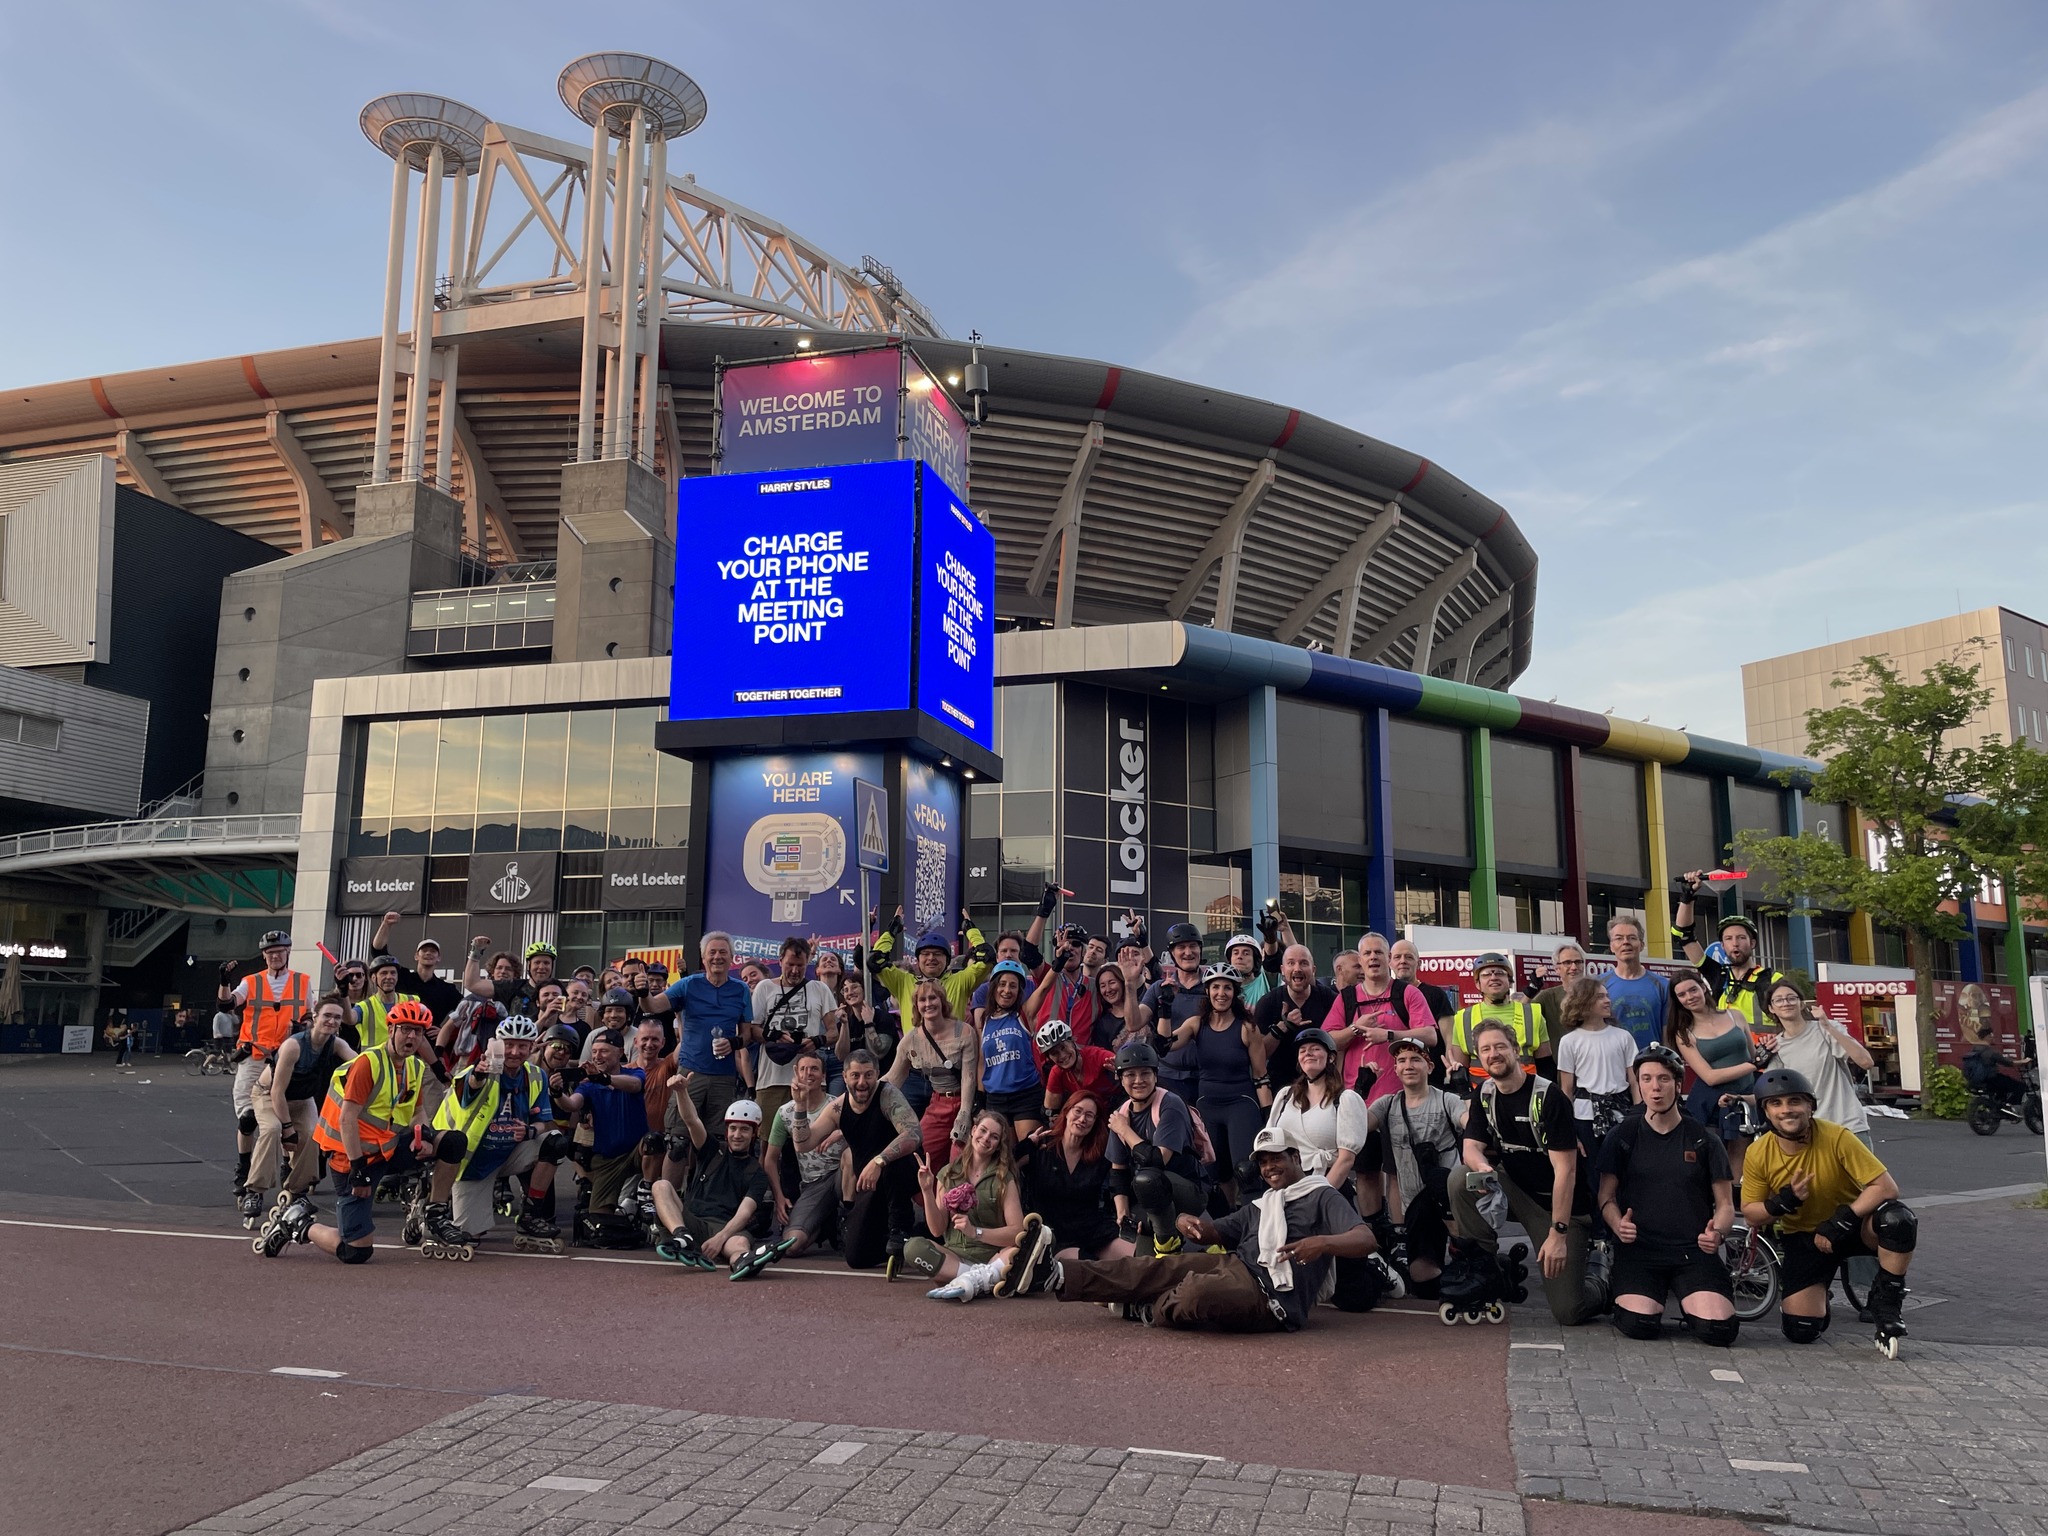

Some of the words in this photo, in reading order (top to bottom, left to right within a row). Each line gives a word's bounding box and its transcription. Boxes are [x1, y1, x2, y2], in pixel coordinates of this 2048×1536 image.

[740, 389, 846, 416] WELCOME
[853, 385, 882, 404] TO
[739, 406, 881, 437] AMSTERDAM
[915, 398, 959, 468] HARRY
[760, 482, 793, 494] HARRY
[794, 479, 830, 491] STYLES
[743, 531, 843, 556] CHARGE
[717, 557, 781, 580] YOUR
[786, 551, 869, 576] PHONE
[945, 550, 976, 594] CHARGE
[751, 579, 781, 600] AT
[785, 576, 832, 598] THE
[936, 563, 957, 599] YOUR
[958, 586, 983, 622] PHONE
[738, 598, 843, 623] MEETING
[947, 596, 957, 619] AT
[957, 603, 973, 633] THE
[754, 621, 826, 644] POINT
[942, 613, 976, 656] MEETING
[948, 639, 971, 672] POINT
[736, 691, 788, 702] TOGETHER
[789, 687, 841, 699] TOGETHER
[762, 773, 796, 788] YOU
[799, 771, 833, 786] ARE
[773, 787, 820, 803] HERE!
[1111, 717, 1145, 895] Locker
[921, 804, 940, 831] FAQ
[347, 880, 373, 893] Foot
[375, 879, 415, 892] Locker
[610, 873, 639, 887] Foot
[642, 872, 686, 886] Locker
[0, 944, 25, 958] opie
[30, 945, 67, 958] Snacks
[1833, 981, 1908, 996] HOTDOGS
[991, 1027, 1023, 1039] ANGELES
[985, 1050, 1021, 1067] DODGERS
